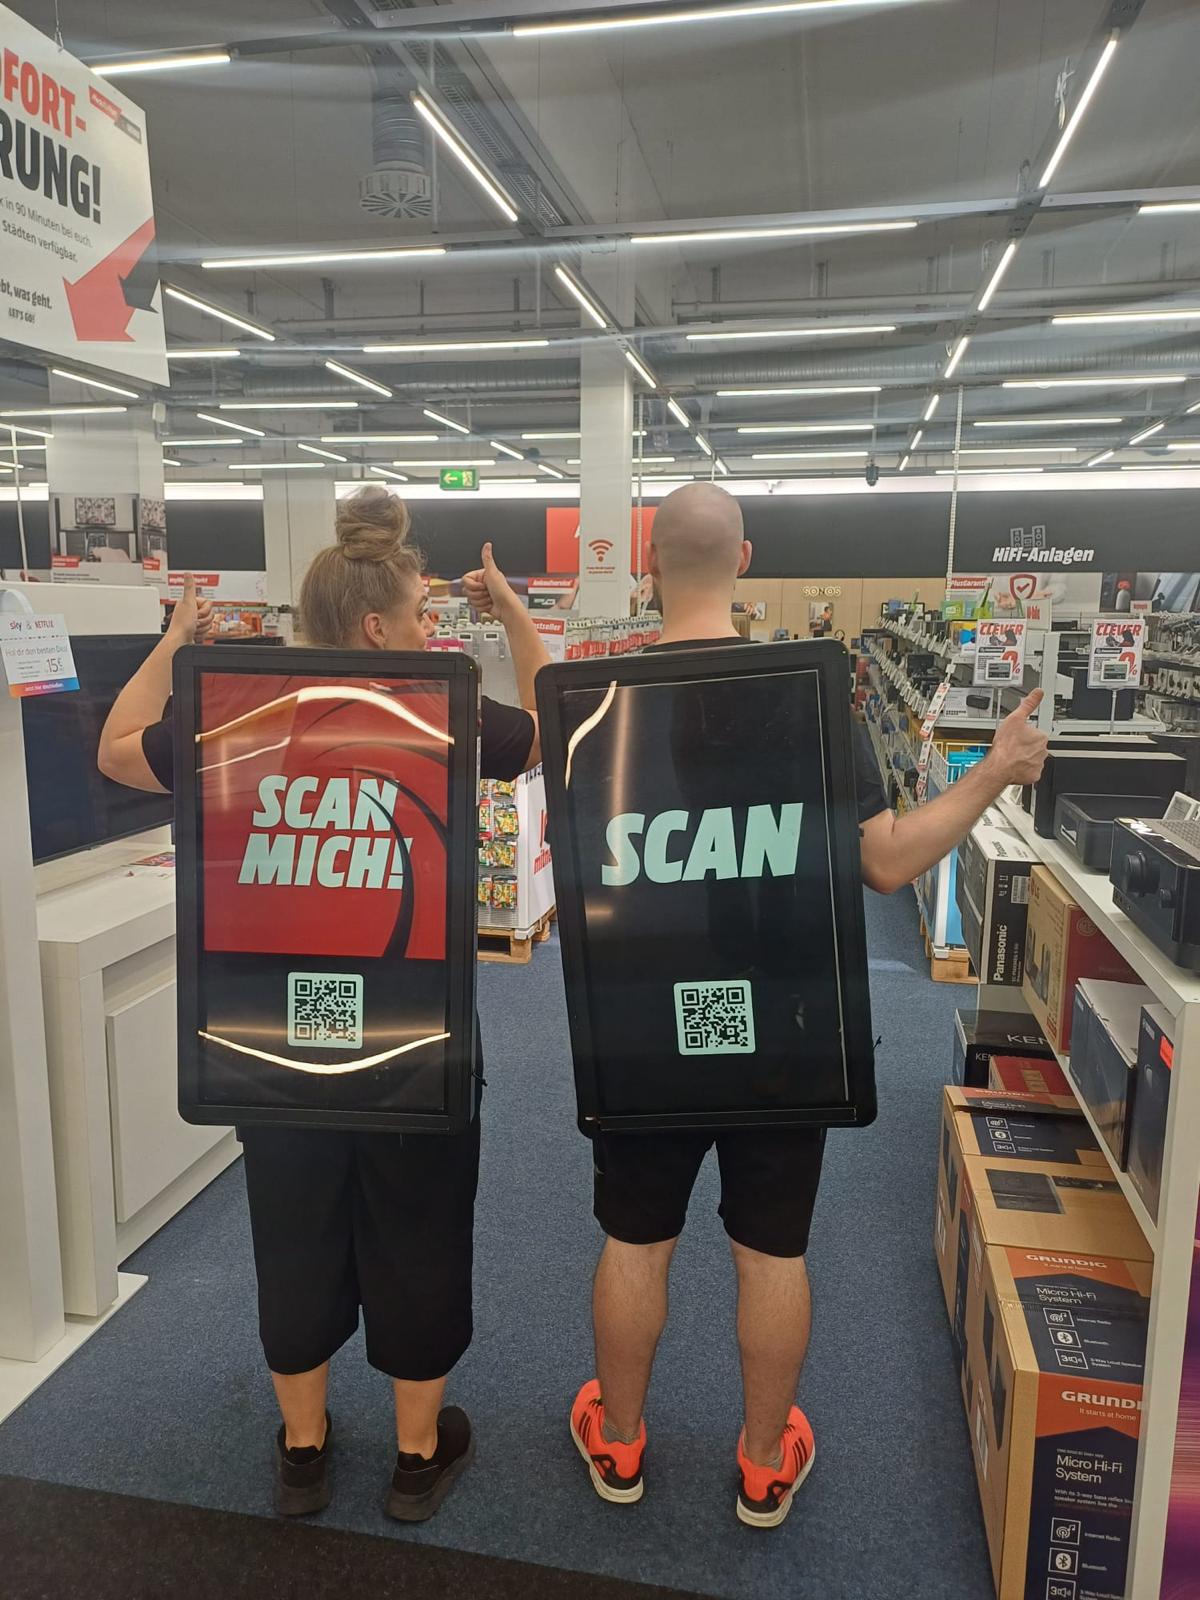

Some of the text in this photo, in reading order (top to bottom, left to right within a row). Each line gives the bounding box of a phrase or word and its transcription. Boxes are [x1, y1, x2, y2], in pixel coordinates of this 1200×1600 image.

[0, 48, 86, 138] FORT-
[15, 202, 26, 216] 90
[27, 208, 60, 232] Minuten
[2, 220, 78, 262] Städten verfügbar.
[14, 286, 31, 302] was
[31, 291, 53, 309] geht.
[992, 547, 1095, 565] HiFi-Anlagen
[803, 585, 841, 597] SONOS
[9, 620, 22, 631] sky
[35, 619, 55, 629] NETFLIX
[980, 623, 1024, 636] CLEVER
[1096, 623, 1142, 637] CLEVER
[252, 775, 399, 831] SCAN
[601, 803, 804, 887] SCAN
[238, 832, 414, 890] MICH!
[993, 924, 1007, 981] Panasonic
[1025, 1254, 1107, 1269] GRUNDIG
[1036, 1287, 1069, 1297] Micro
[1071, 1291, 1097, 1301] Hi-Fi
[1038, 1295, 1082, 1304] System
[1116, 1412, 1136, 1420] home
[1056, 1454, 1122, 1473] Micro Hi-Fi
[1056, 1467, 1102, 1484] System
